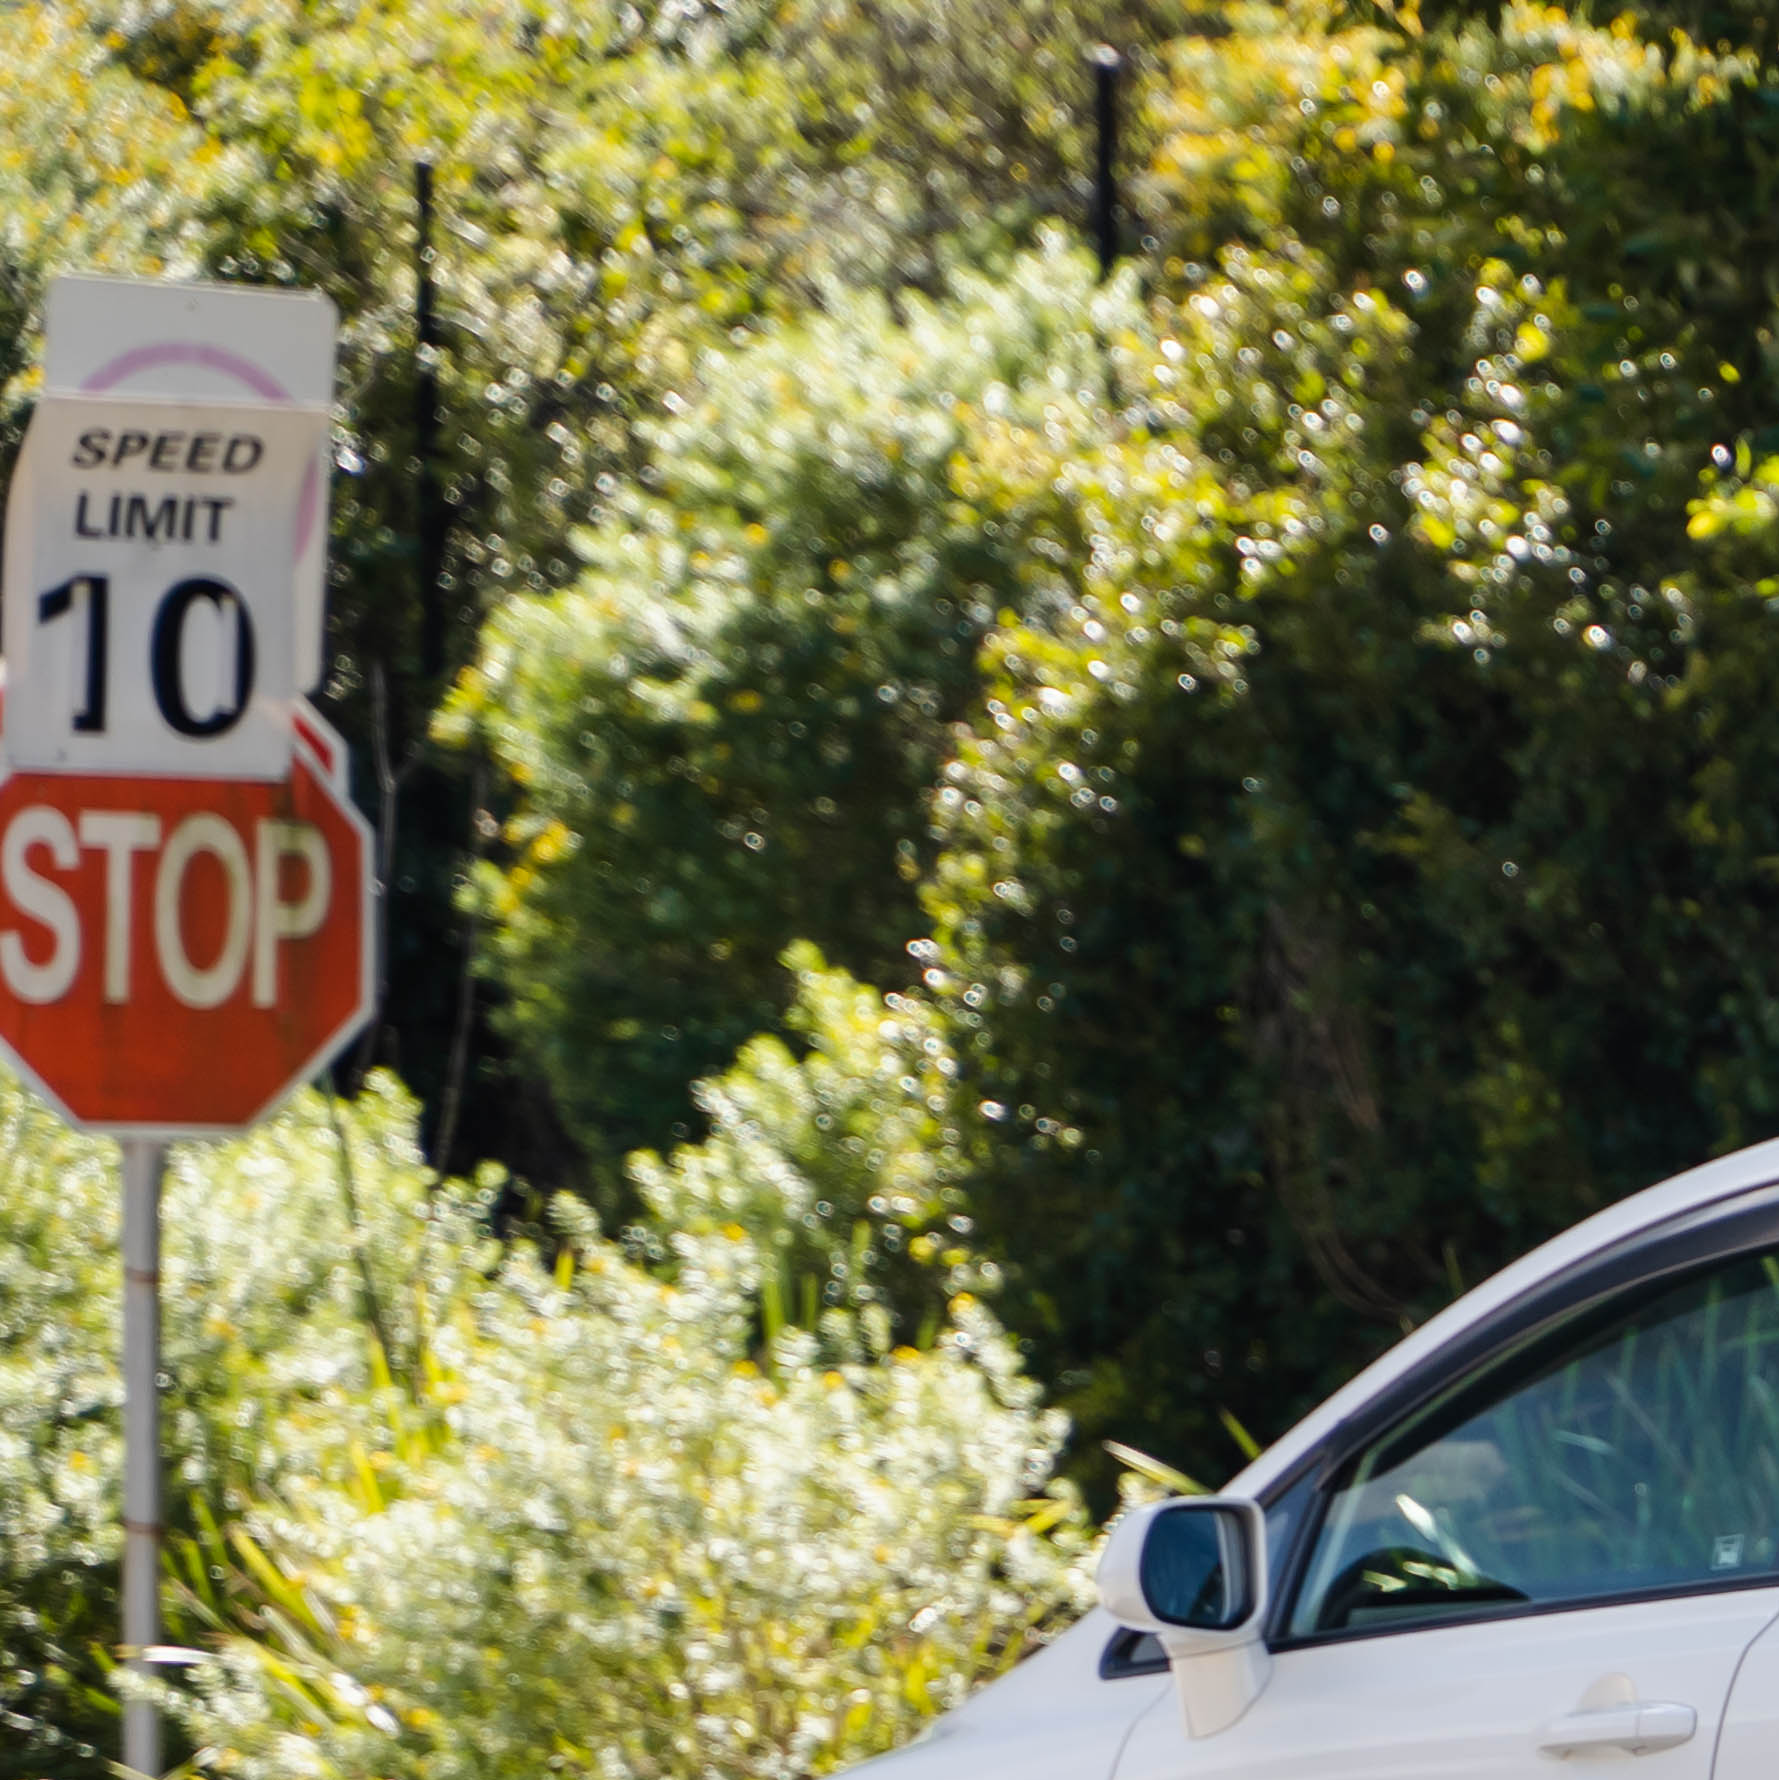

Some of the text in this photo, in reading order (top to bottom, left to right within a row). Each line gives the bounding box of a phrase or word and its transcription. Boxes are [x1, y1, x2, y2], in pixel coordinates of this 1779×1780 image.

[71, 427, 265, 475] SPEED
[75, 491, 234, 543] LIMIT
[37, 571, 257, 739] 10
[0, 804, 333, 1010] STOP
